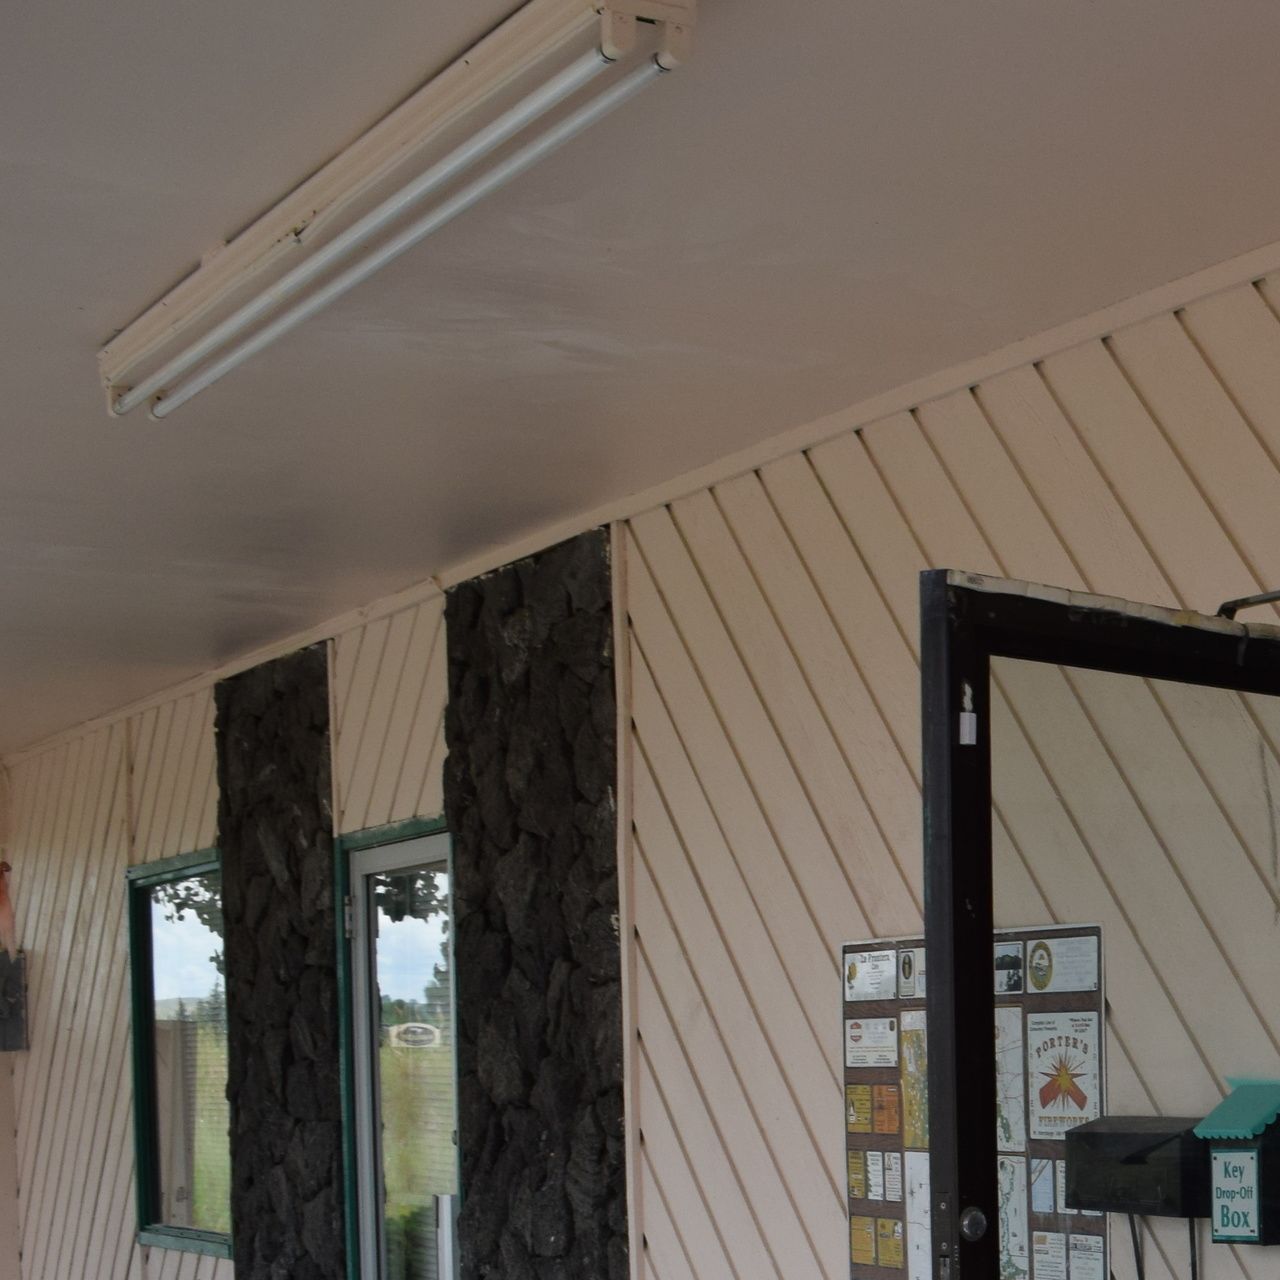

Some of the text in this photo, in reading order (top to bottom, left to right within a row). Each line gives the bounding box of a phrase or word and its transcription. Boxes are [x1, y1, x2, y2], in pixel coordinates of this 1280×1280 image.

[1035, 1035, 1089, 1059] PORTER'S
[1223, 1161, 1245, 1183] Key
[1215, 1186, 1253, 1202] Drop-Off
[1221, 1204, 1251, 1228] Box
